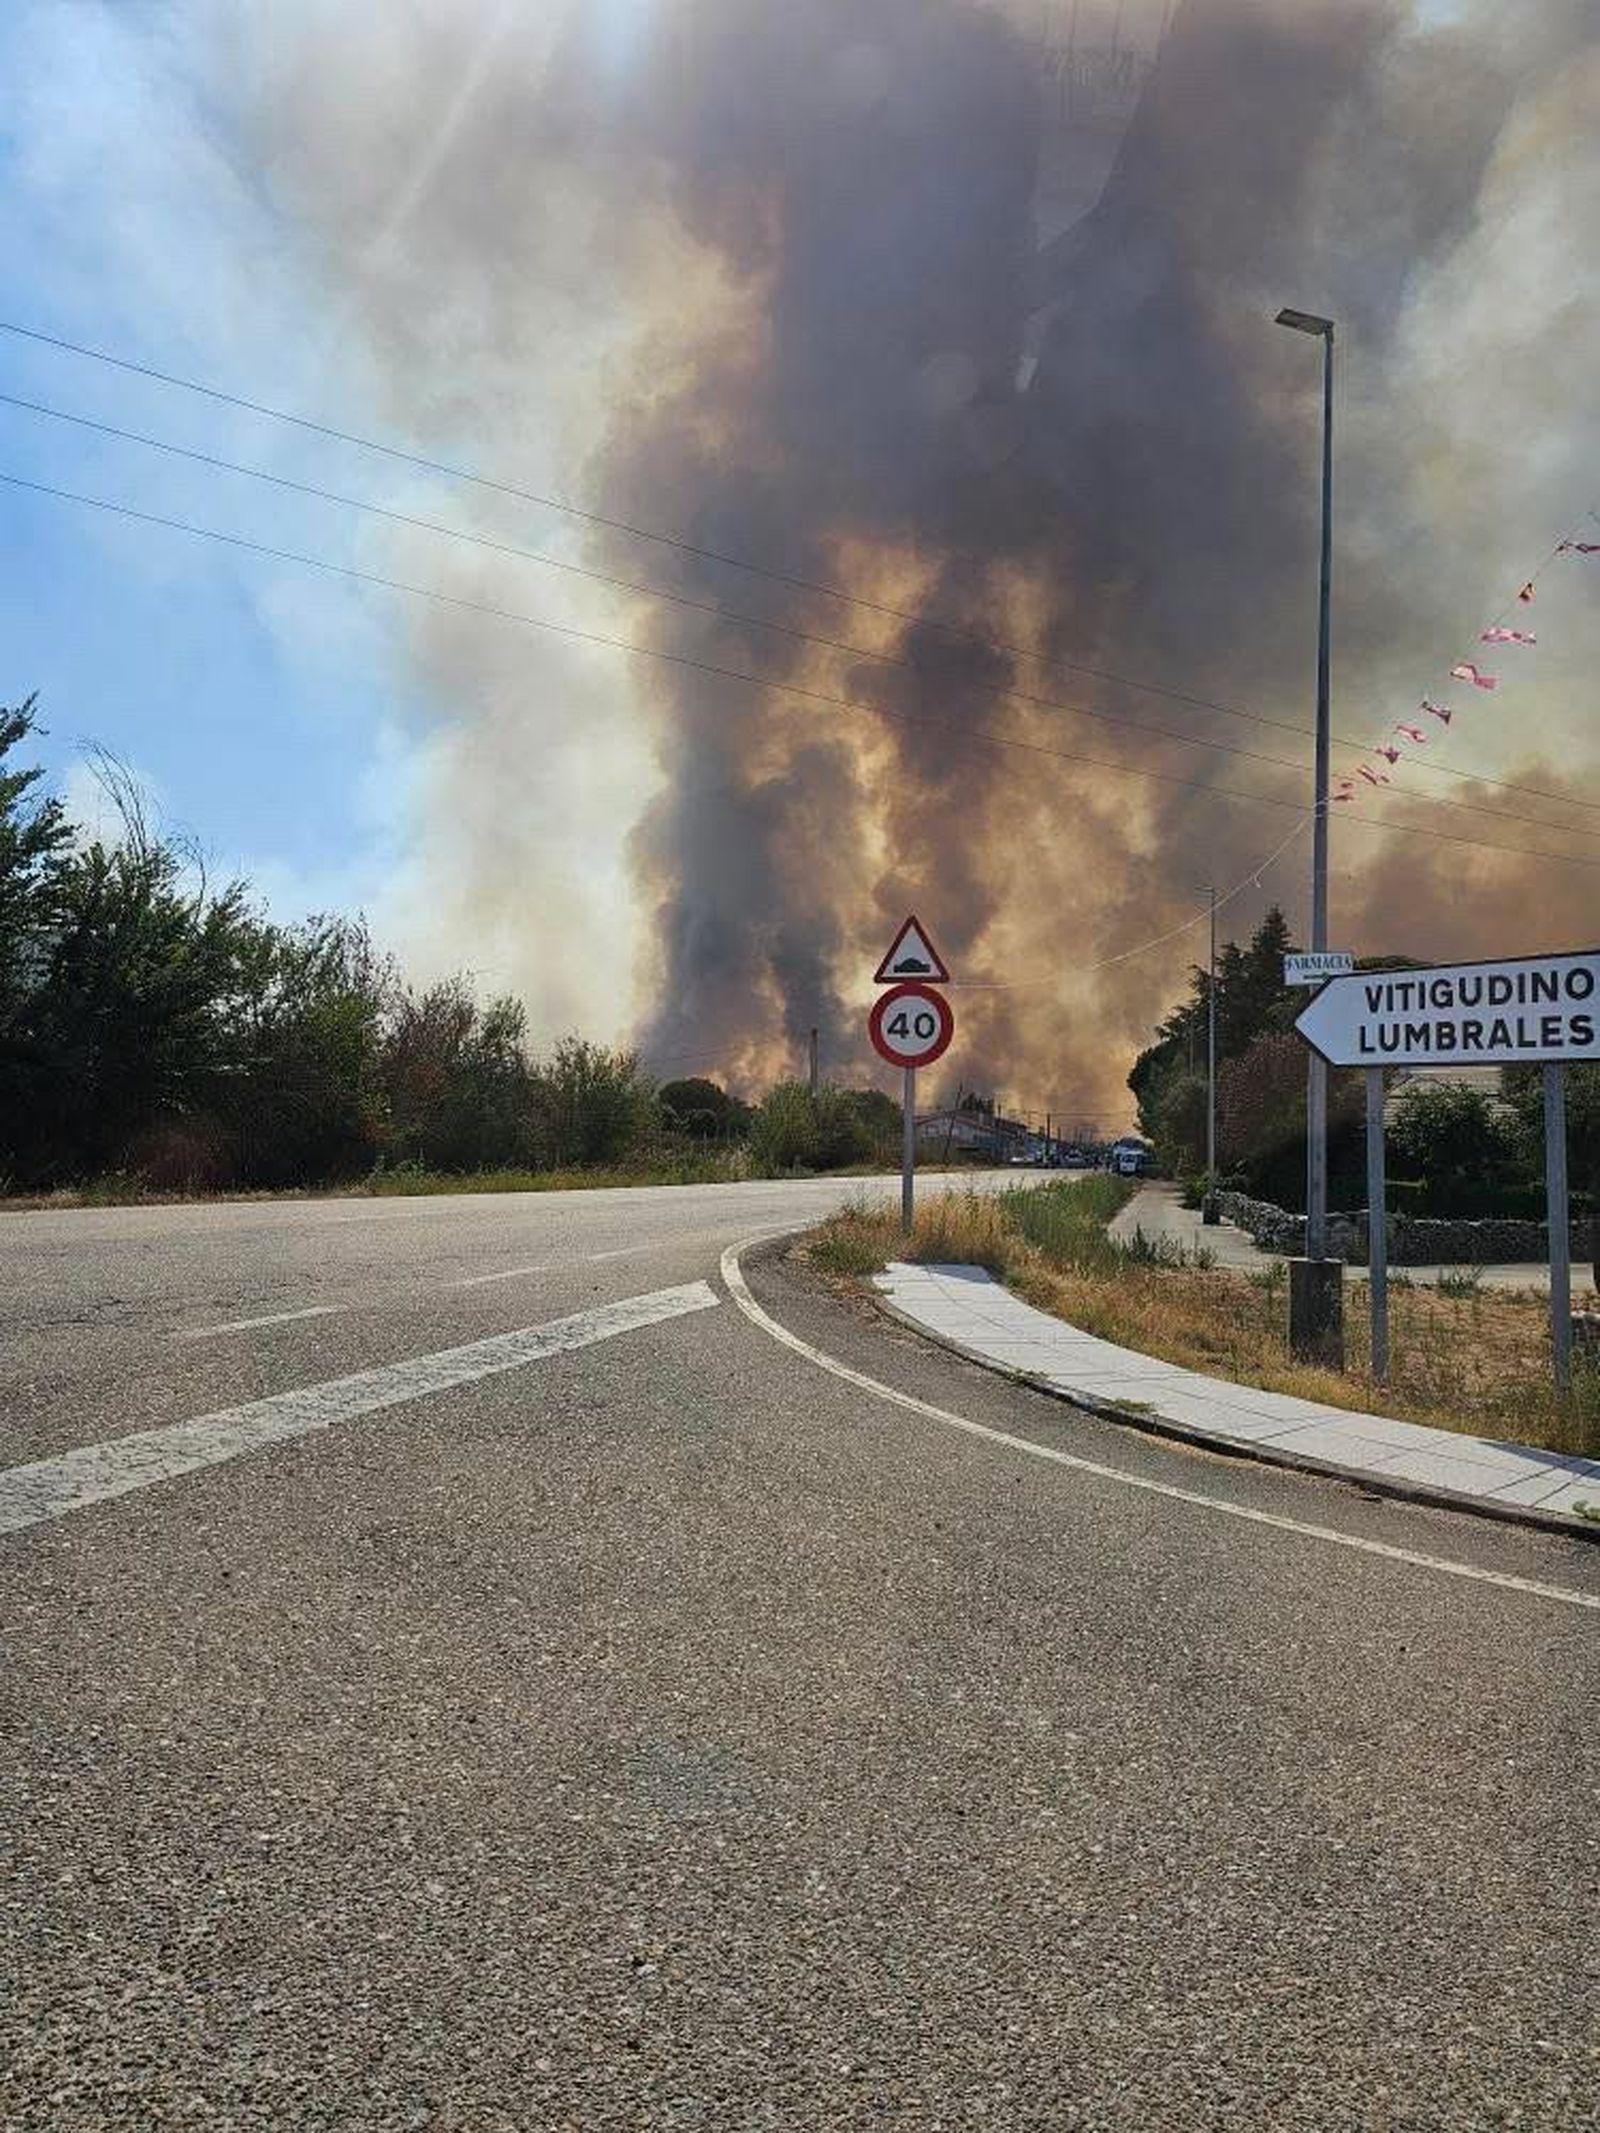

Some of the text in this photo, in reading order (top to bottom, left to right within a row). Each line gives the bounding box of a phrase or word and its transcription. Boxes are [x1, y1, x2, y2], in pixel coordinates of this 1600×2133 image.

[1365, 967, 1595, 1013] VITIGUDINO
[887, 1012, 936, 1040] 40
[1359, 1015, 1595, 1053] LUMBRALES
